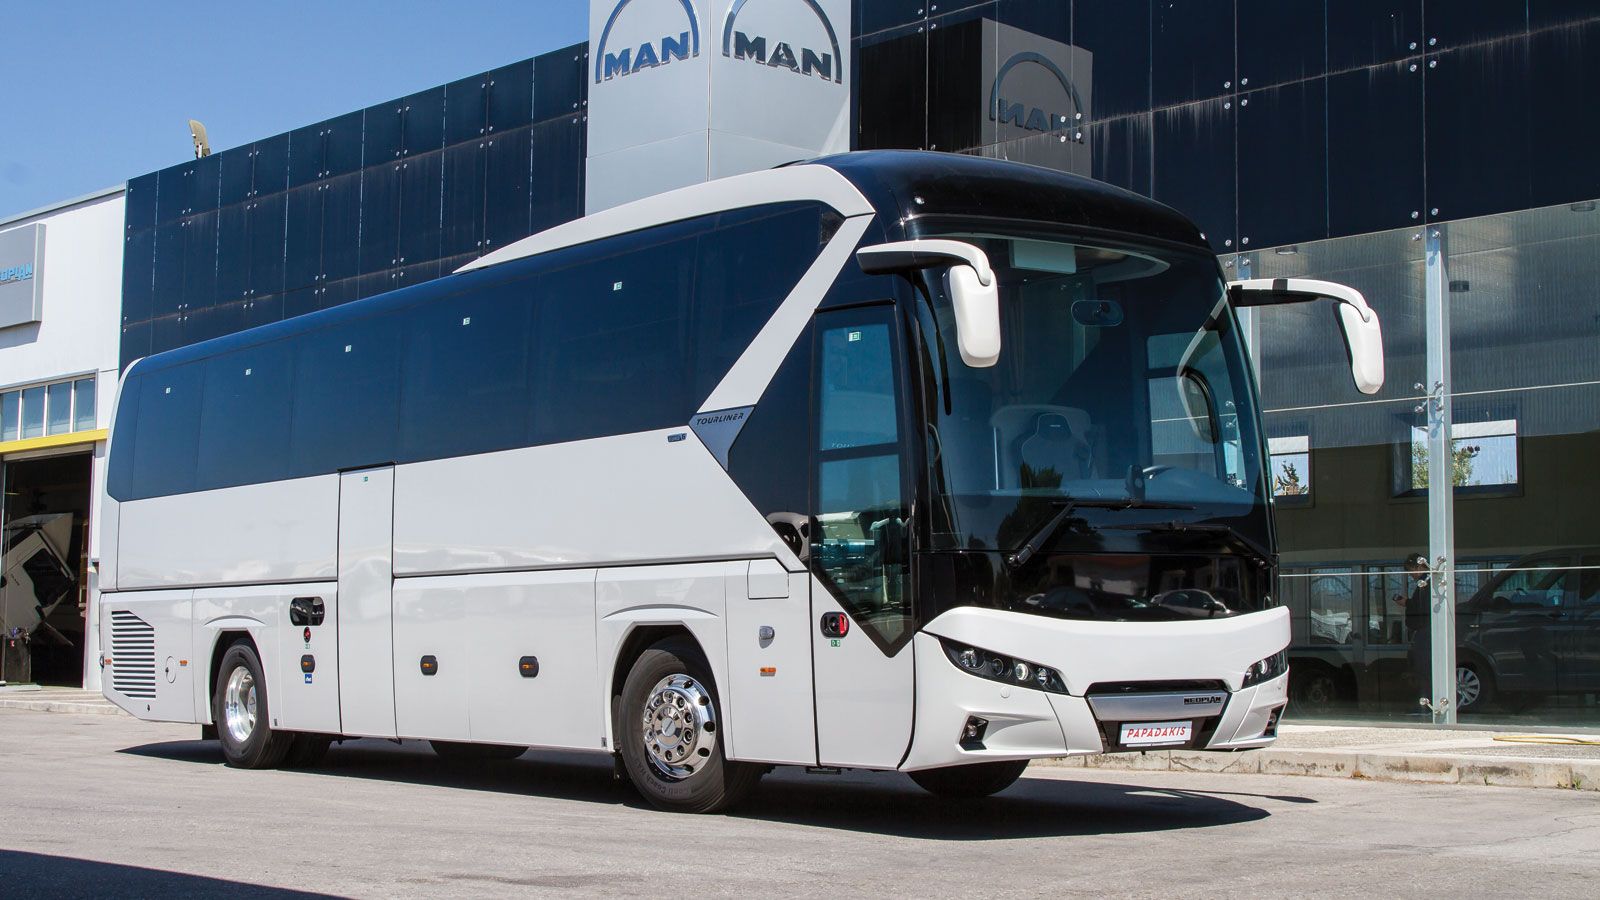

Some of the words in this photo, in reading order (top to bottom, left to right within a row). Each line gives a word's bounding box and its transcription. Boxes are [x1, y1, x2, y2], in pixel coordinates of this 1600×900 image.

[604, 31, 690, 81] MAN
[734, 31, 831, 81] MAN
[0, 262, 33, 281] OPLAN
[696, 413, 744, 425] TOURLINER
[1184, 696, 1222, 705] NEOPLAN
[1126, 726, 1187, 739] PAPADAKIS
